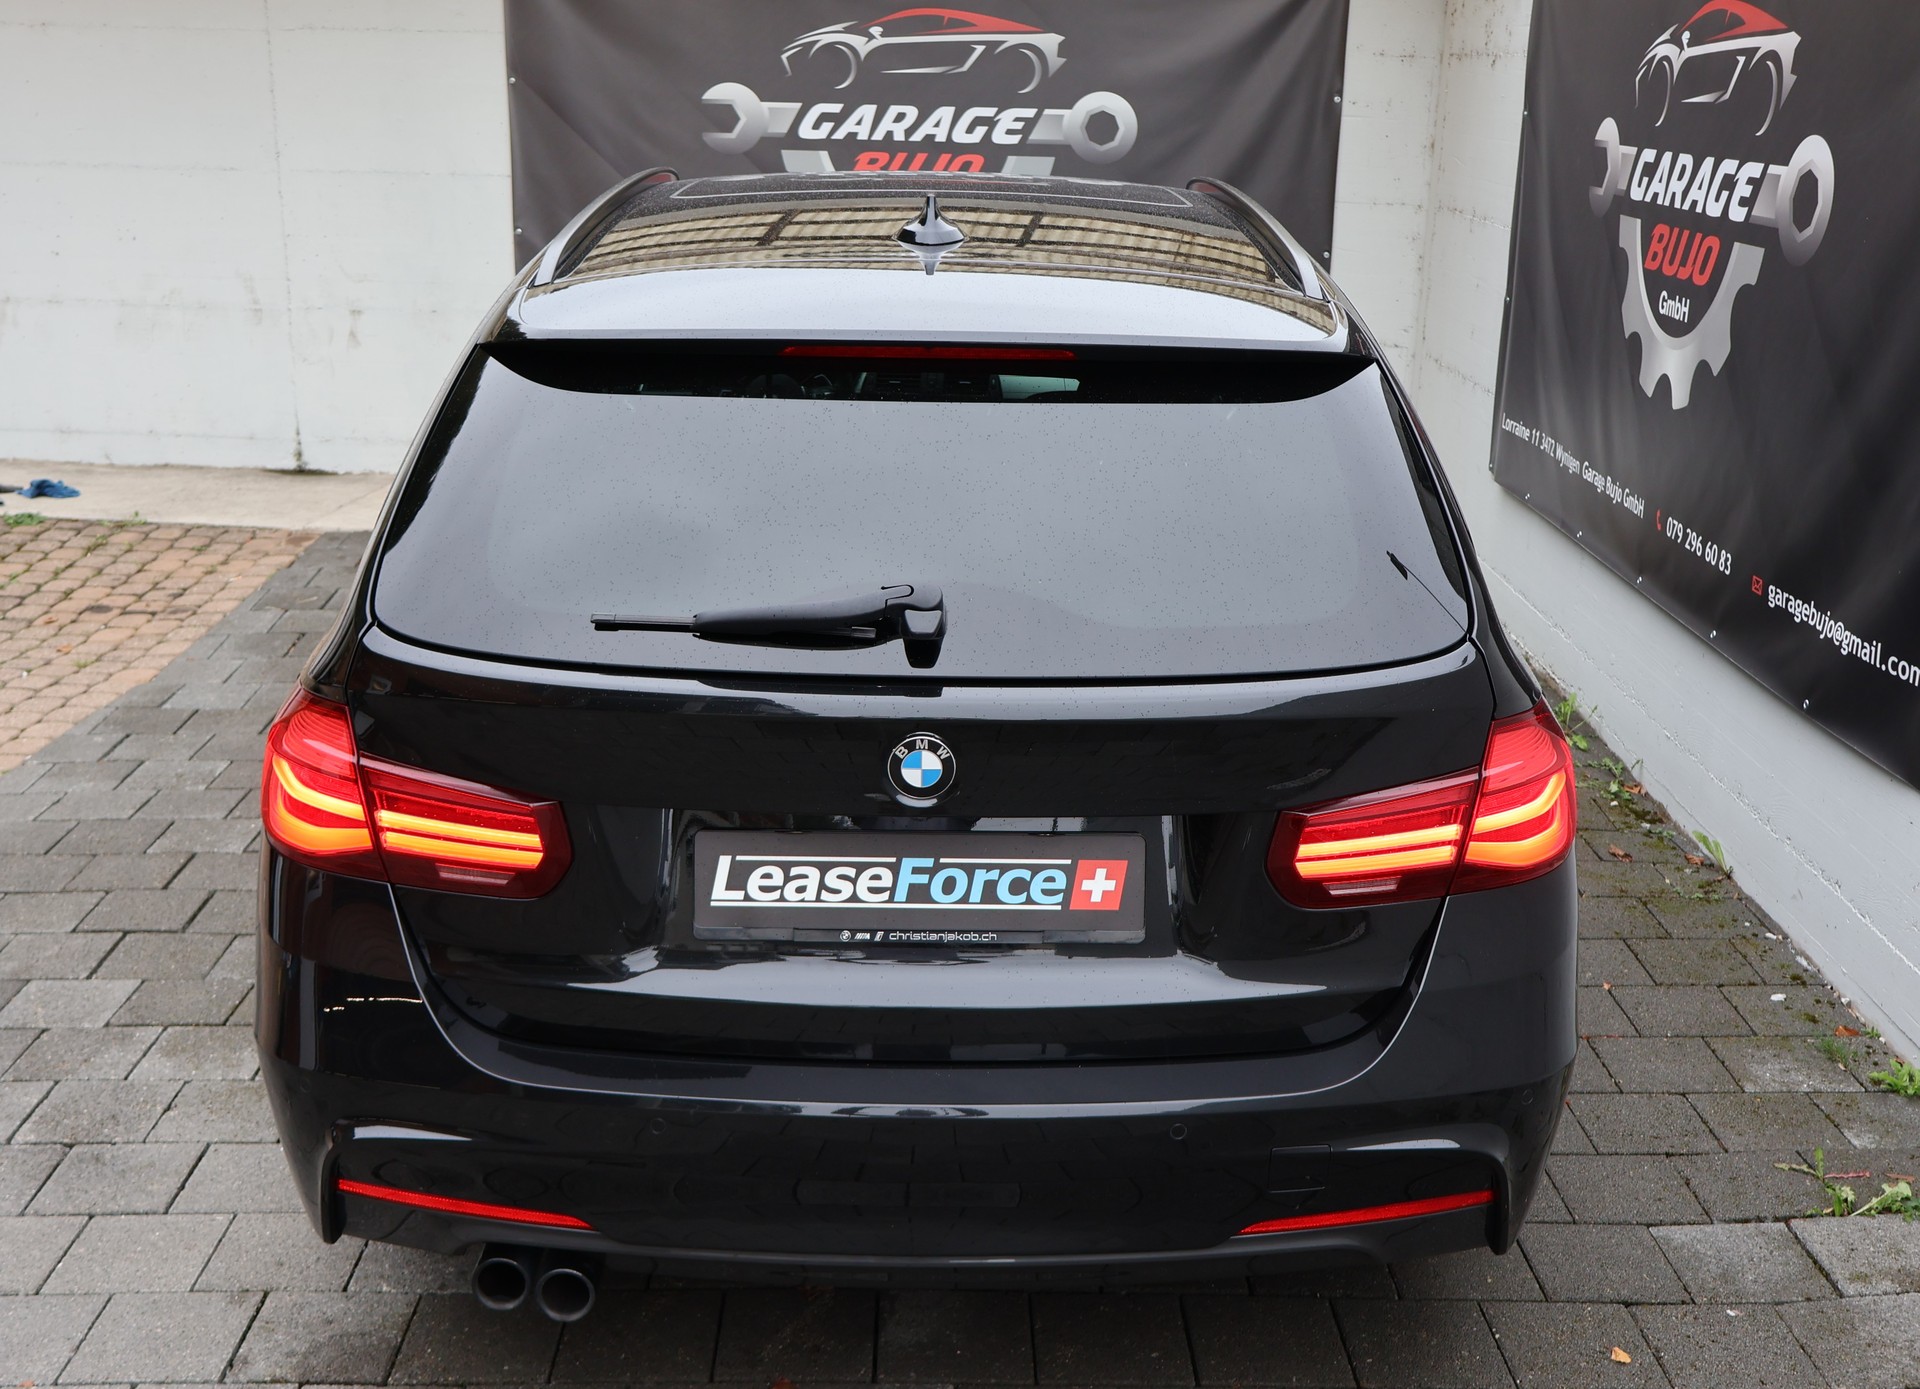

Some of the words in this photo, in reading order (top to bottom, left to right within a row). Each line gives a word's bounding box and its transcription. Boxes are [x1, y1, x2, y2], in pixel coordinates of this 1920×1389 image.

[798, 102, 1038, 144] GARAGE
[1630, 148, 1765, 222] GARAGE
[1644, 223, 1721, 286] BUJO
[1658, 290, 1690, 323] GmbH
[1501, 412, 1530, 441] Lorraine
[1531, 428, 1540, 447] 11
[1540, 433, 1555, 457] 3472
[1555, 441, 1580, 474] Wynigen
[1582, 461, 1605, 493] Garage
[1605, 475, 1622, 504] Bujo
[1623, 488, 1645, 519] GmbH
[1666, 516, 1683, 543] 079
[1684, 528, 1702, 556] 296
[1705, 541, 1718, 566] 60
[1719, 549, 1731, 575] 83
[895, 739, 950, 760] BMW
[710, 855, 1068, 905] LeaseForce
[888, 930, 998, 943] christianjakob.ch
